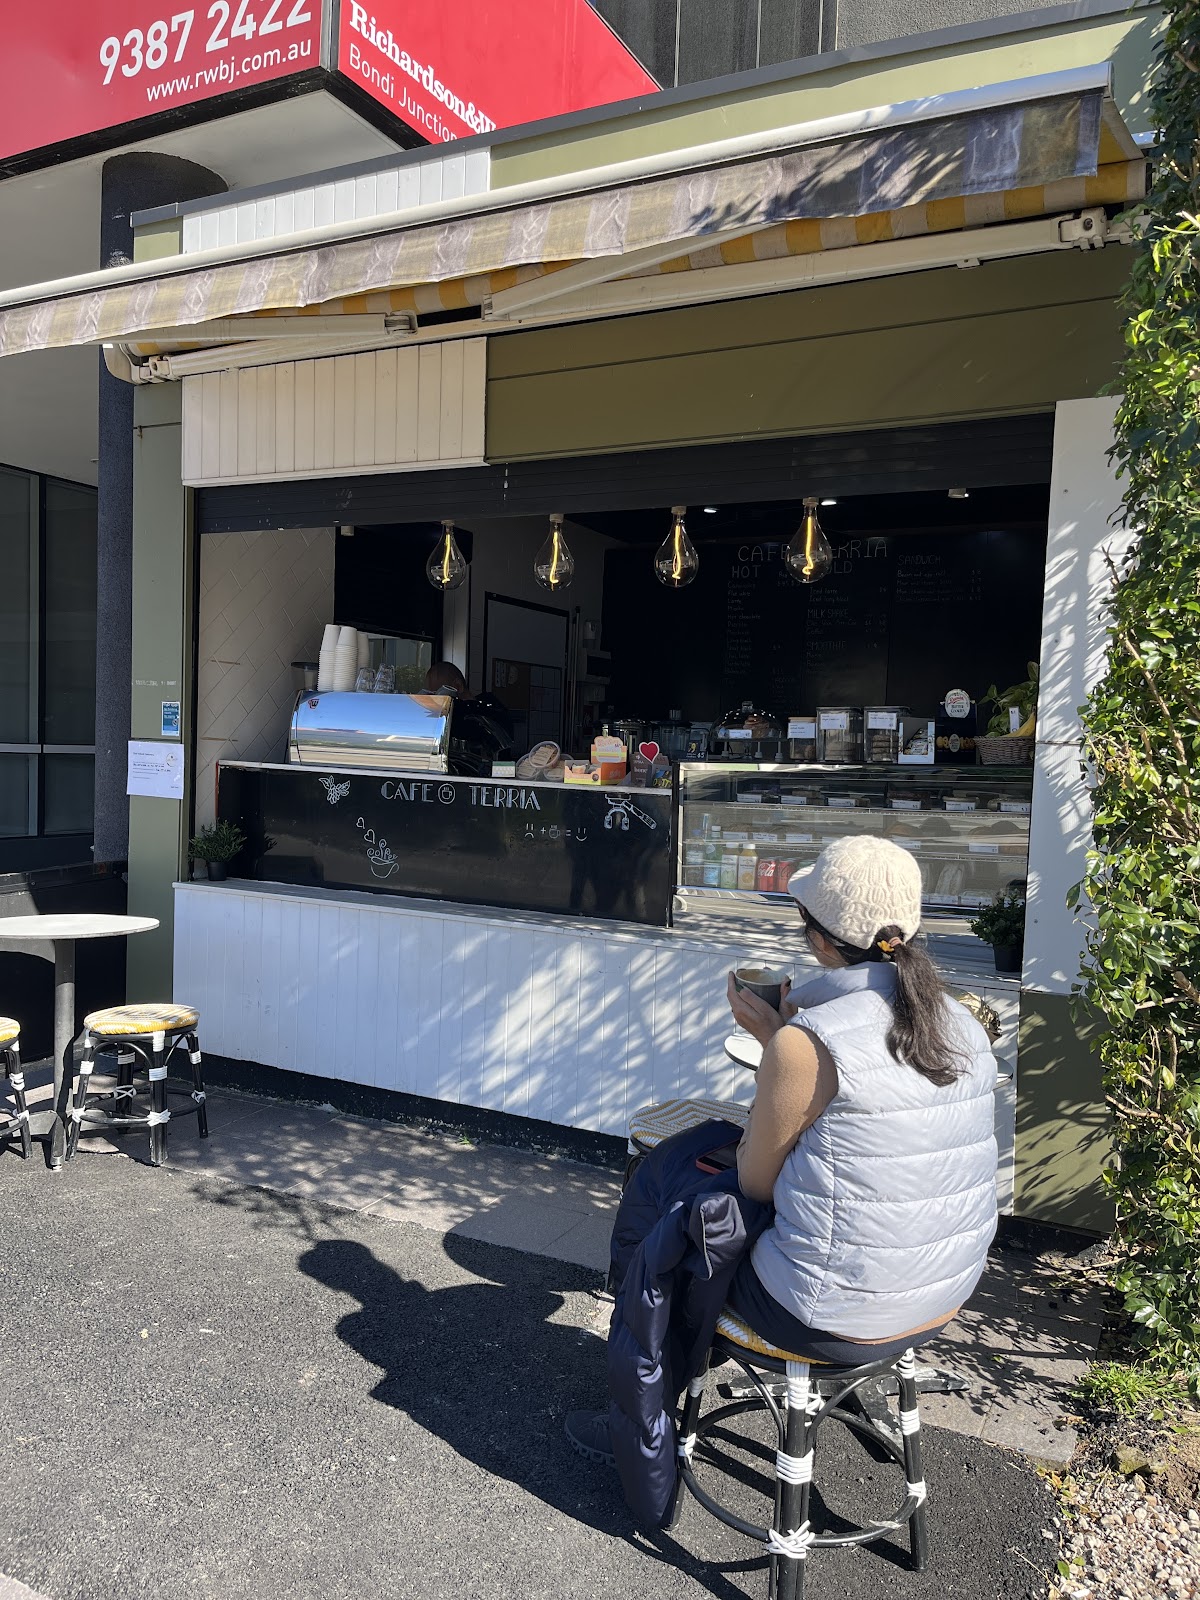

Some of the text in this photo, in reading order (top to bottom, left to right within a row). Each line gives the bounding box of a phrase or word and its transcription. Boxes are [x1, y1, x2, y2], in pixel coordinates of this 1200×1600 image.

[99, 0, 312, 86] 9387 2422
[146, 38, 312, 102] www.rwbj.com.au
[349, 43, 395, 99] Bondi
[737, 539, 888, 562] CAFE RRIA
[898, 554, 942, 566] SANDWICH
[732, 565, 762, 579] HOT
[808, 608, 826, 619] MILK
[380, 781, 542, 811] CAFE TERRIA
